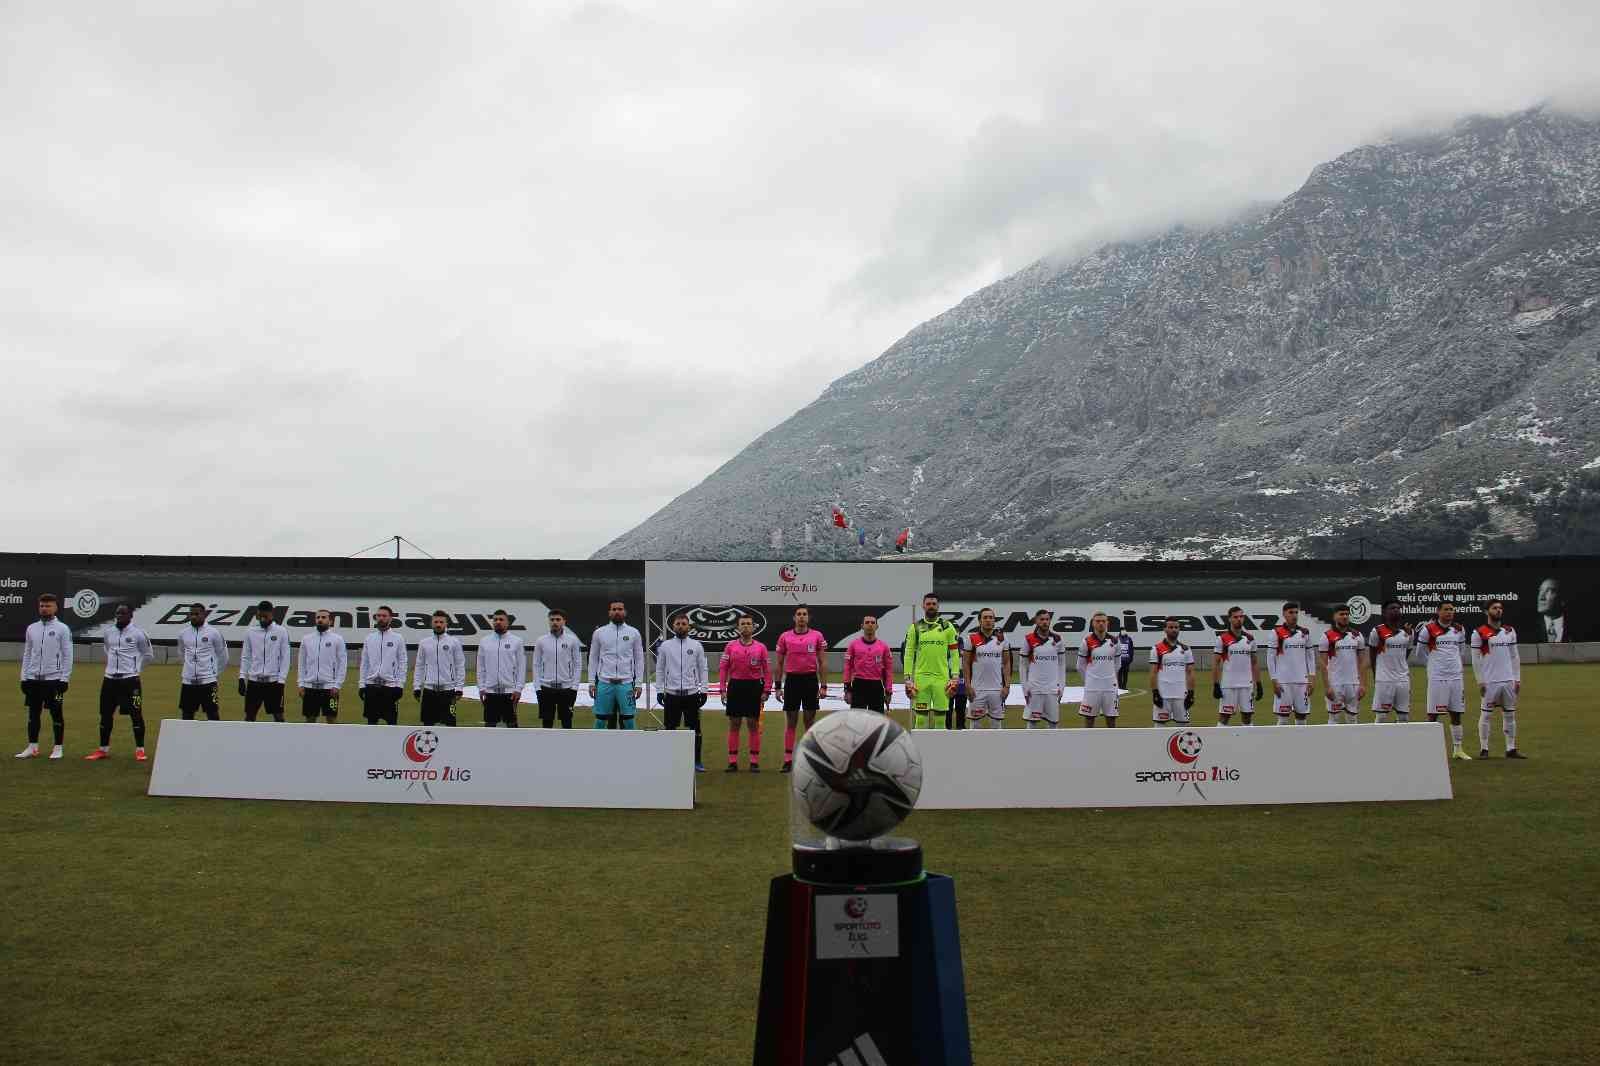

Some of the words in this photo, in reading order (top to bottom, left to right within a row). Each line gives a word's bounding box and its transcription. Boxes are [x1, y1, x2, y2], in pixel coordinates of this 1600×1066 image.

[0, 577, 28, 588] ulara
[1396, 582, 1414, 591] Ben
[0, 593, 23, 604] erim
[1443, 594, 1454, 602] ve
[1476, 592, 1519, 601] zamanda
[367, 769, 437, 780] SPORTOTO
[1135, 771, 1206, 782] SPORTOTO
